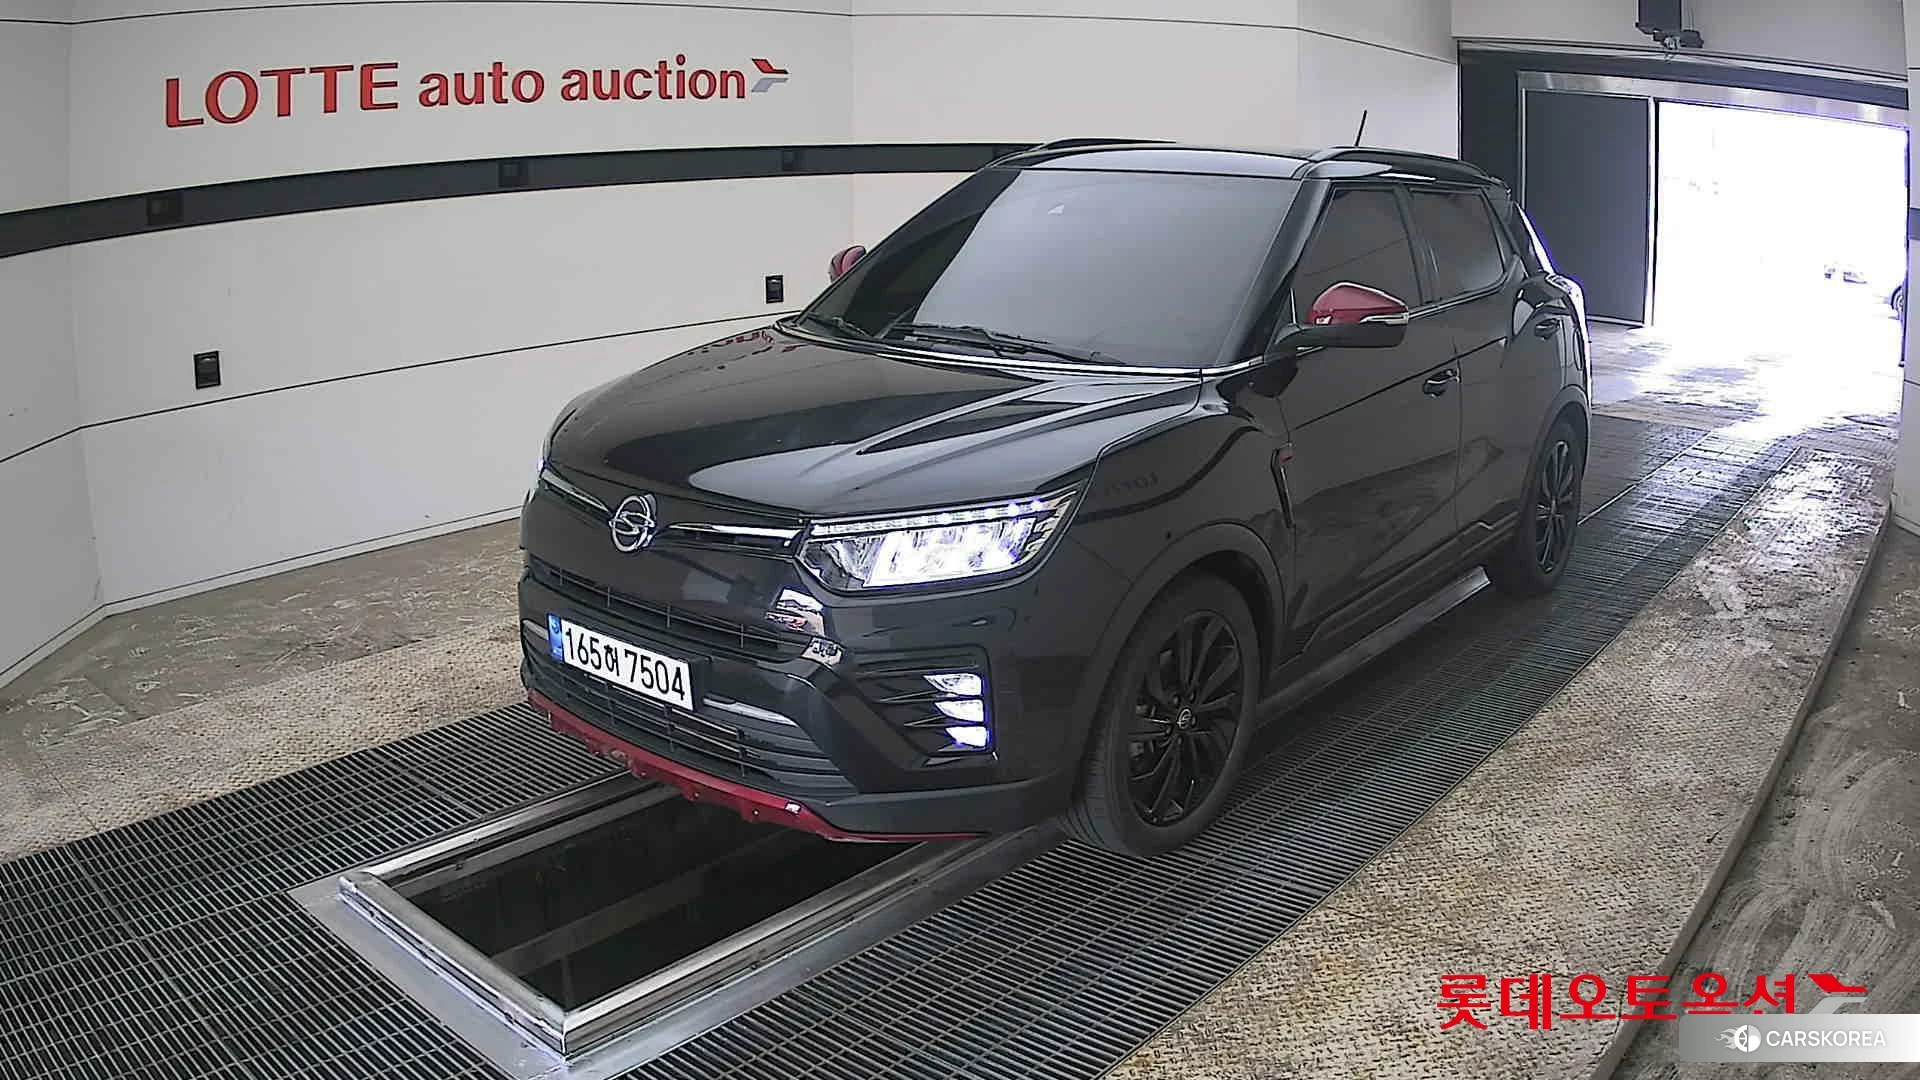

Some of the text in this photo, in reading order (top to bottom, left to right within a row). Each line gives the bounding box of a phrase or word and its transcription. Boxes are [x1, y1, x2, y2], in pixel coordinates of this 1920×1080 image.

[166, 54, 746, 128] LOTTE auto auction
